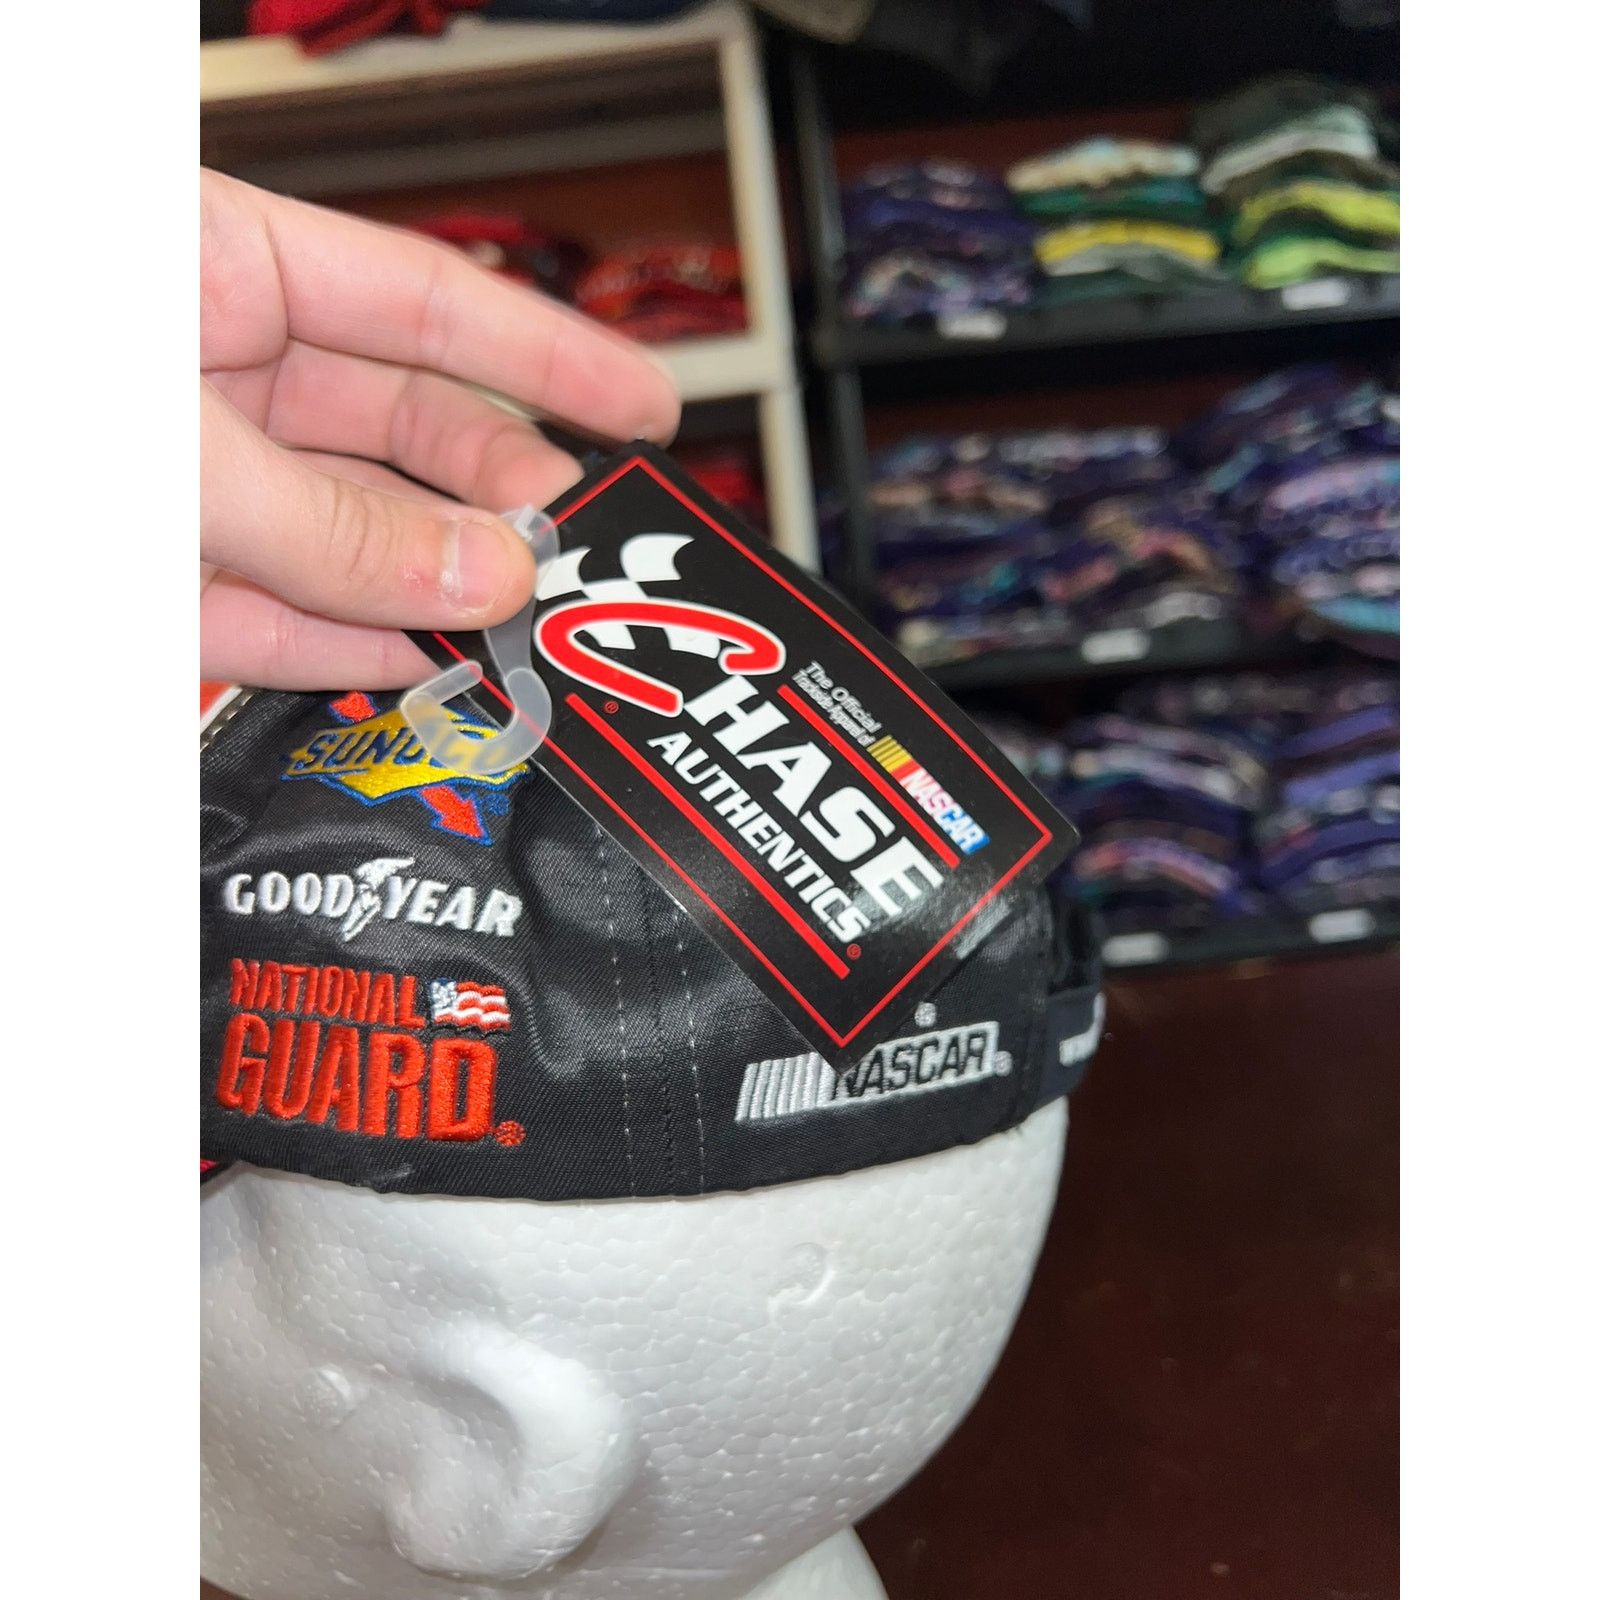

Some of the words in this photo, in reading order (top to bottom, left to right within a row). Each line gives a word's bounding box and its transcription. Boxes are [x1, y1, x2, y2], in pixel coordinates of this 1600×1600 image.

[791, 668, 834, 712] Trackside
[828, 704, 867, 740] Apparel
[805, 660, 834, 690] The
[831, 686, 882, 734] Official
[533, 598, 945, 917] CHASE
[647, 731, 871, 943] AUTHENTICS
[898, 766, 989, 854] NASCAR
[228, 957, 426, 1030] NATIONAL
[216, 1012, 498, 1142] GUARD
